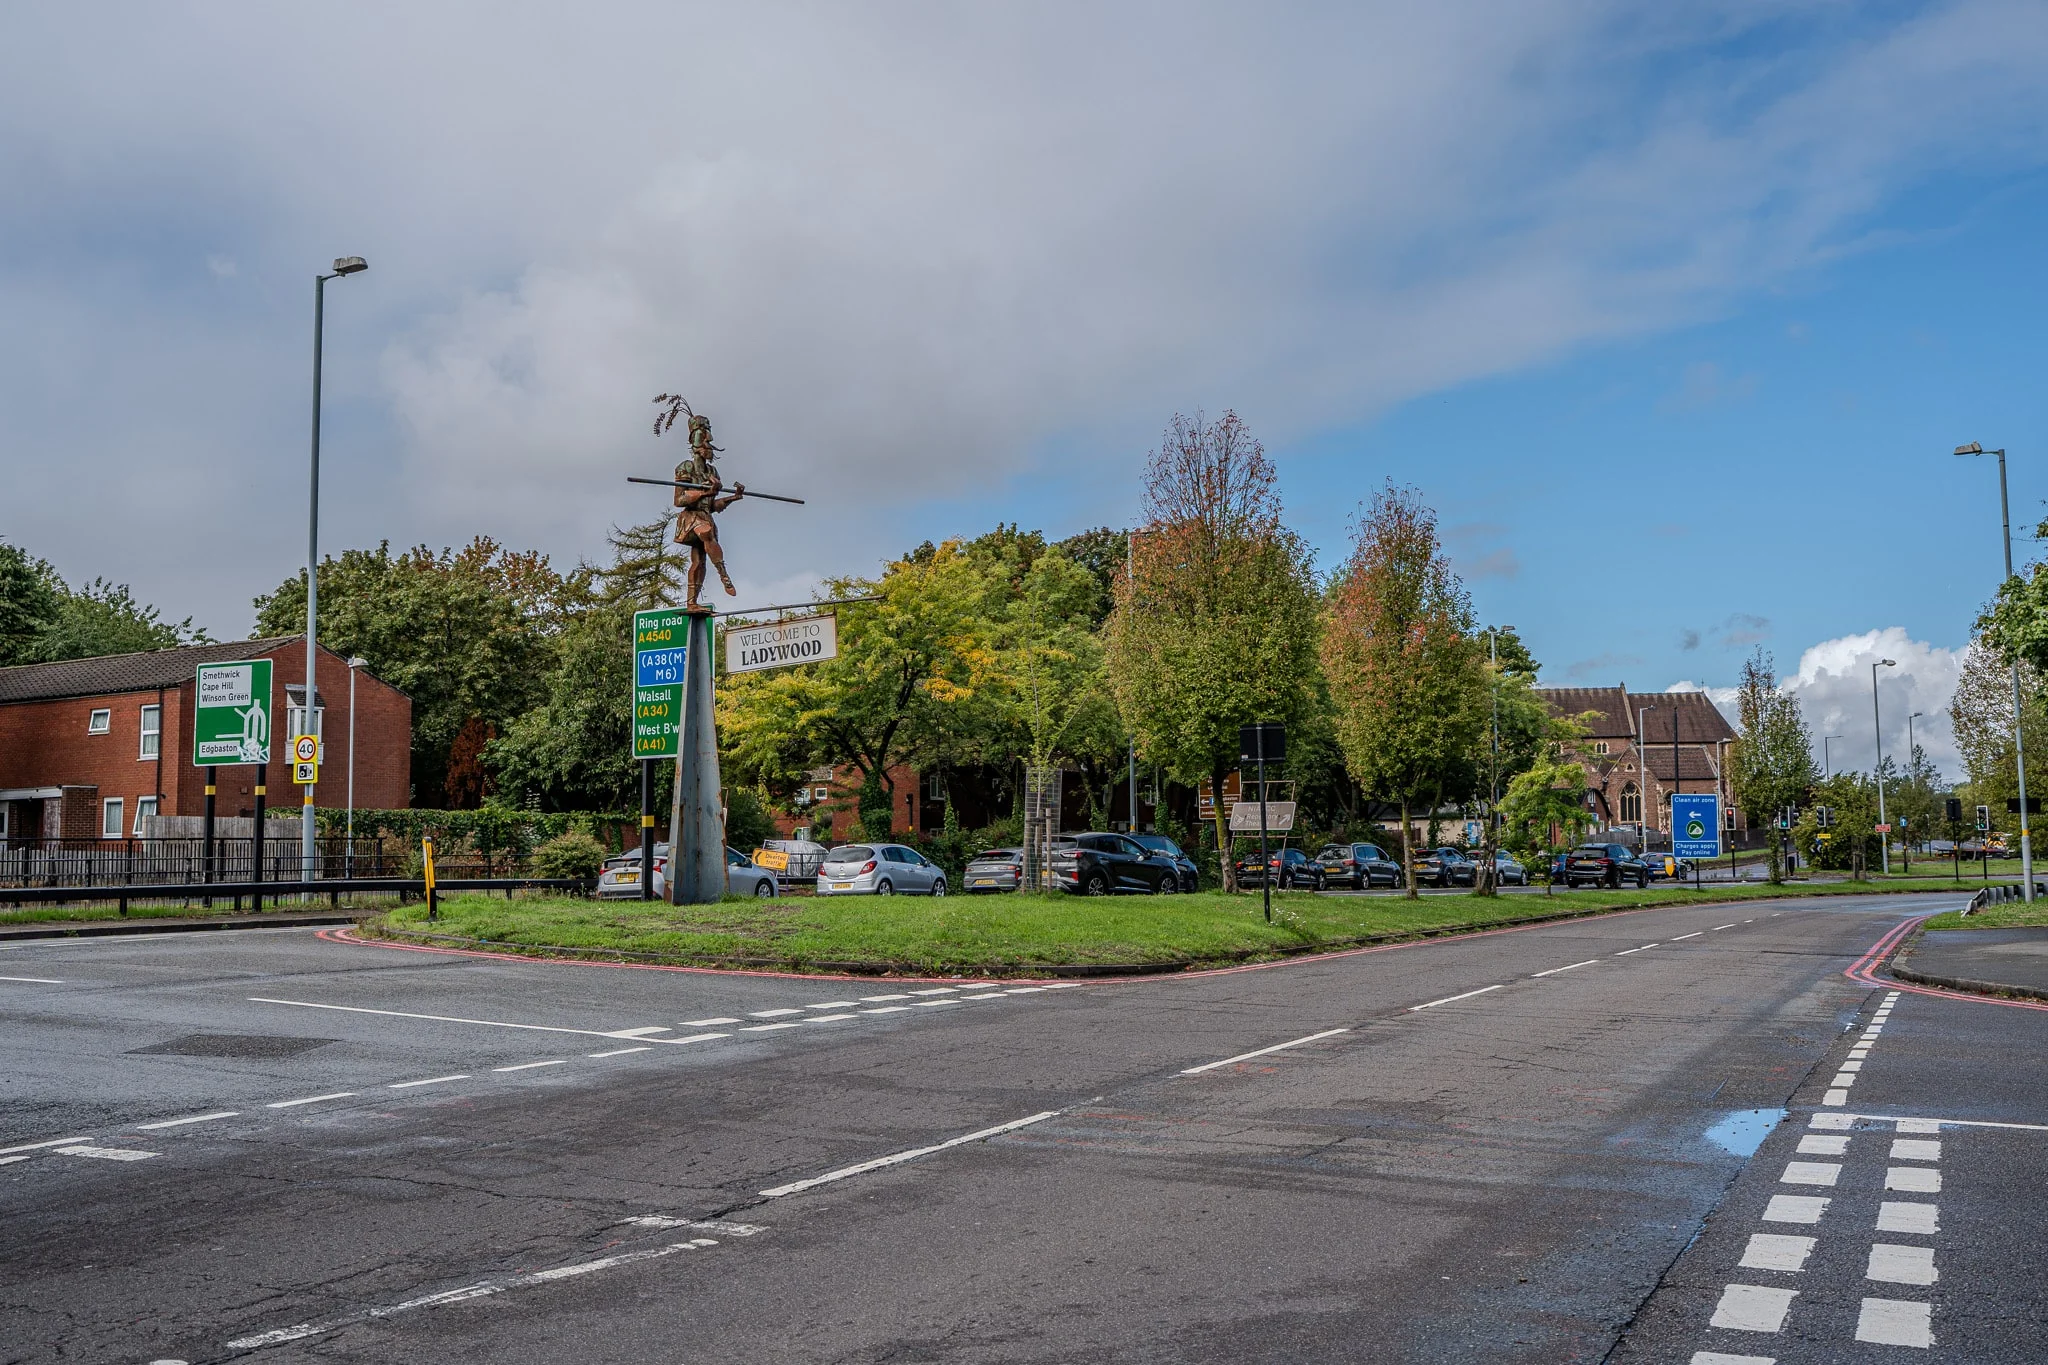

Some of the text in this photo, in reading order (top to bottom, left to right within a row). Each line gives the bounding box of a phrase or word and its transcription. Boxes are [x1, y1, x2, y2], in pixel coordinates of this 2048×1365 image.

[639, 616, 683, 629] Ring road
[638, 629, 672, 643] A4540
[740, 624, 820, 647] WELCOME TO
[742, 639, 822, 666] LADYWOOD
[202, 670, 241, 680] Smethwick
[655, 667, 677, 681] M6)
[202, 682, 234, 692] Cape Hill
[202, 693, 249, 702] Winson Green
[638, 689, 672, 702] Walsall
[637, 703, 669, 719] (A34)
[638, 724, 661, 736] West
[201, 744, 238, 754] Edgbaston
[299, 744, 314, 754] 40
[637, 737, 667, 752] (A41)
